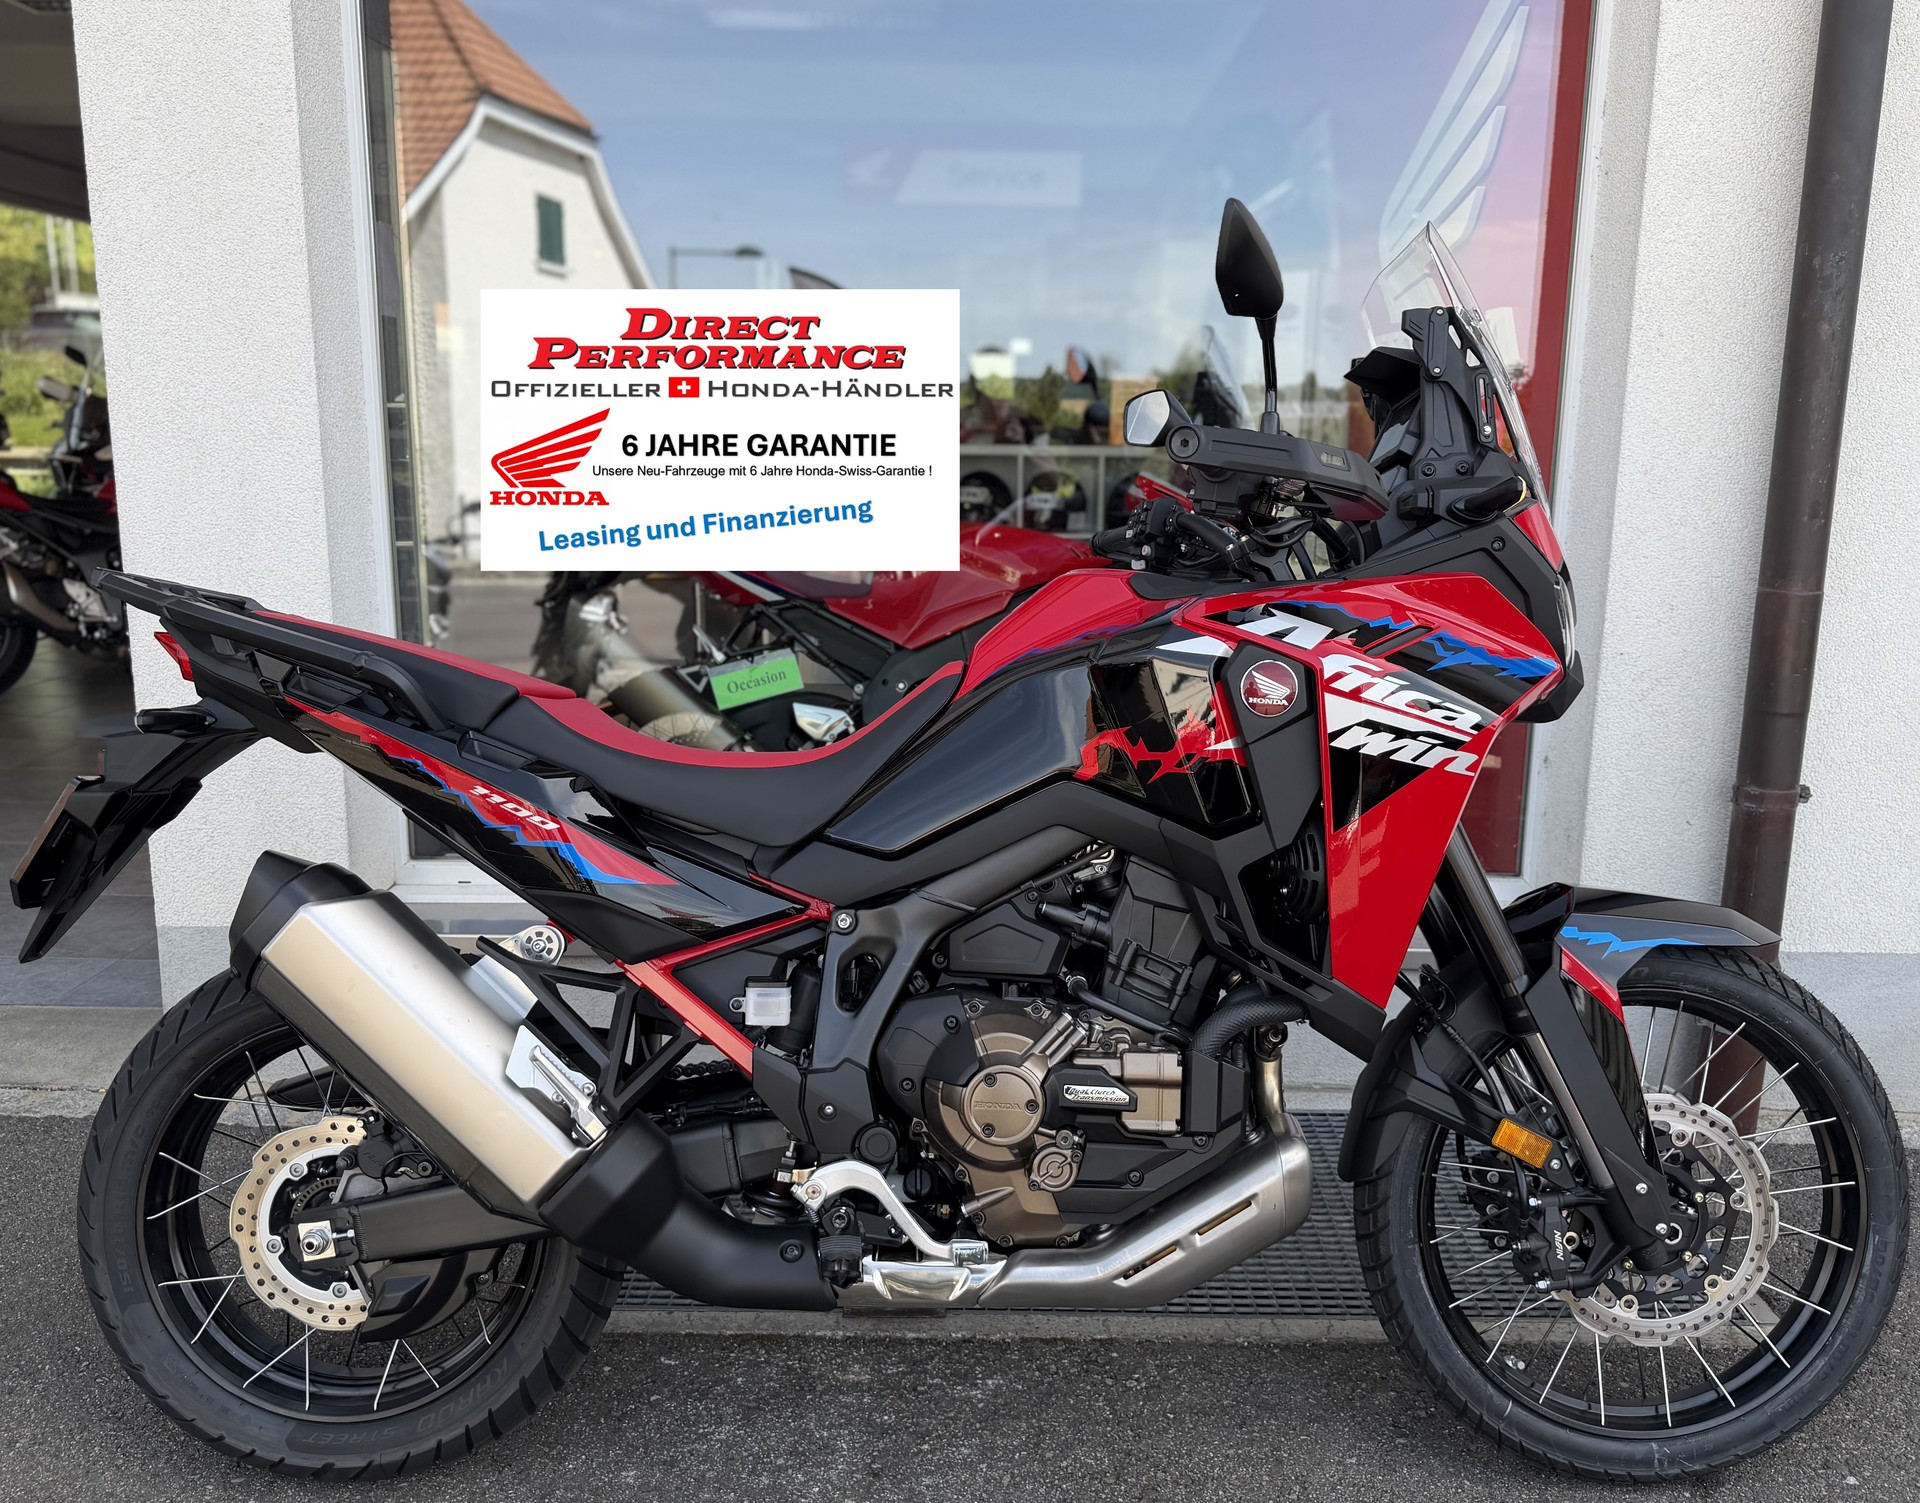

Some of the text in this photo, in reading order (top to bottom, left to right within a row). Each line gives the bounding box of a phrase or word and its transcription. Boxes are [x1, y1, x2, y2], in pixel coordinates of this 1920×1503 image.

[727, 670, 787, 694] Occasion
[1248, 697, 1289, 706] HONDA
[468, 785, 561, 830] 1100
[973, 1101, 1023, 1111] HONDA
[301, 1425, 400, 1446] STREET
